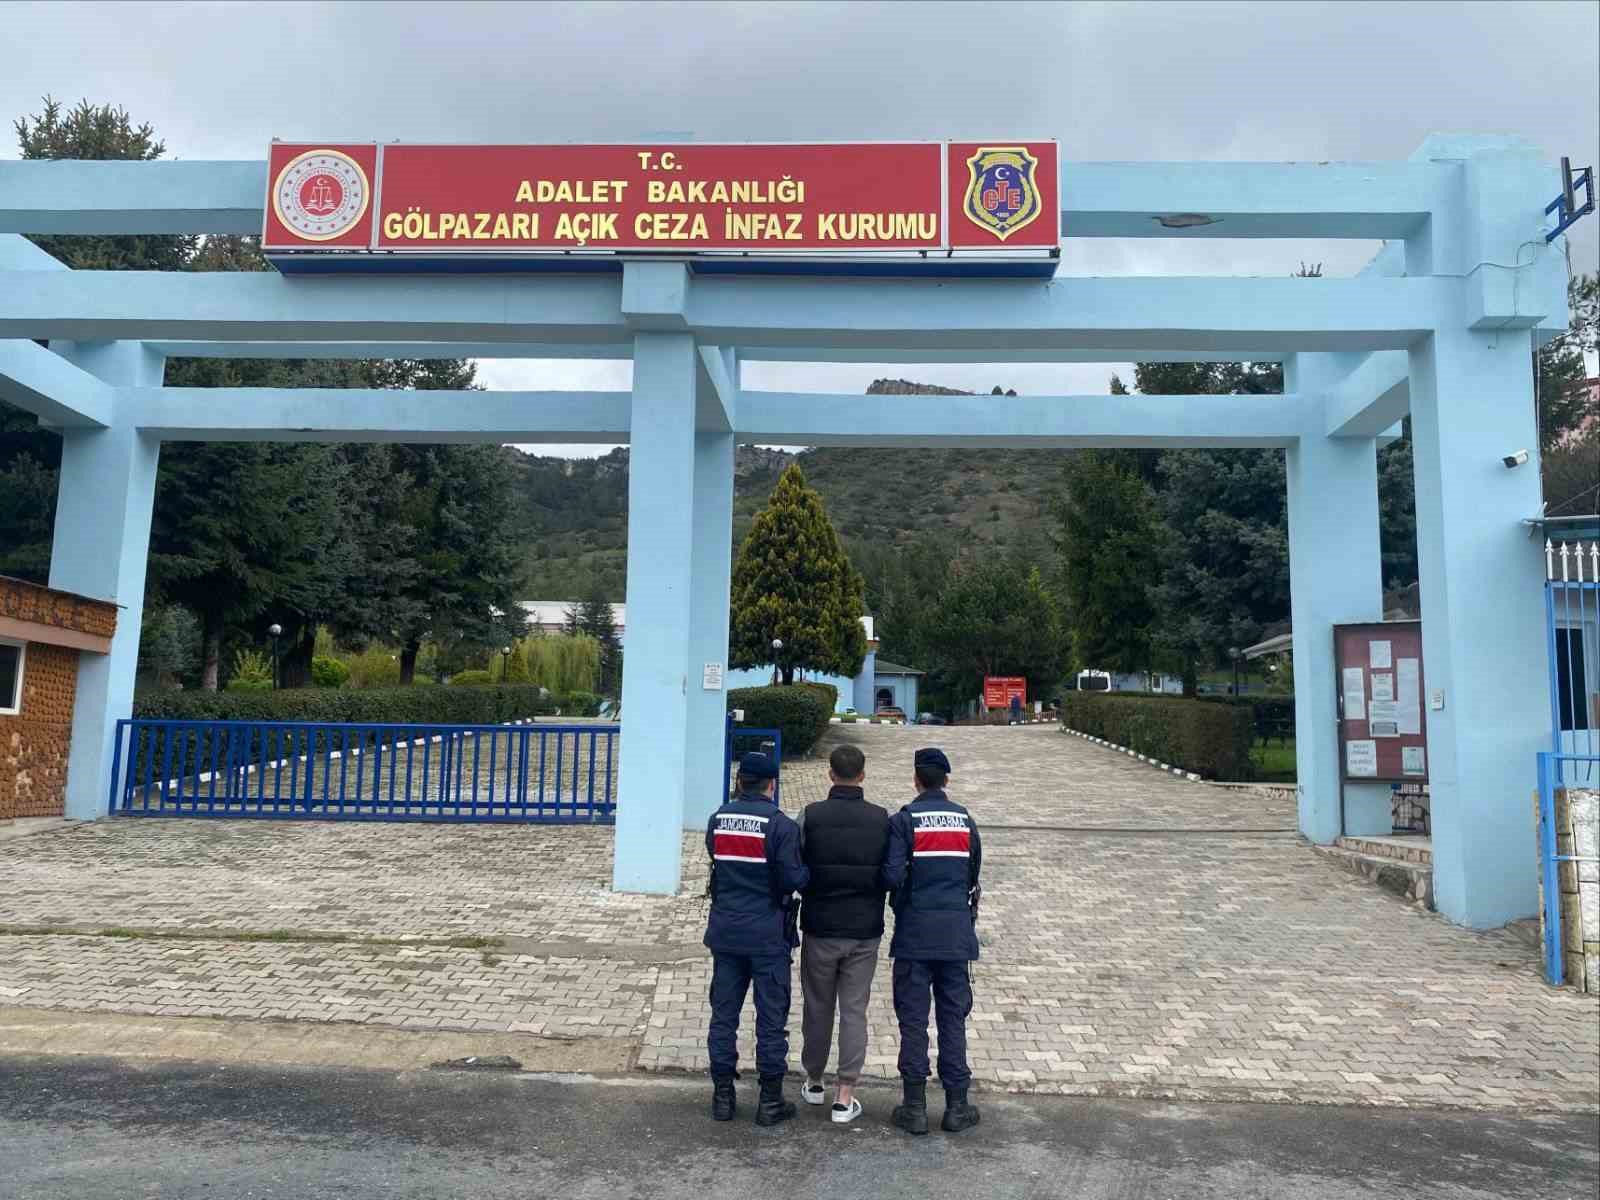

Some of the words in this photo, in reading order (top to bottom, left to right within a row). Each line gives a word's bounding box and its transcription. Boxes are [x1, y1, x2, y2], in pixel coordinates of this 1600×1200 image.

[638, 151, 683, 170] T.C.
[516, 180, 629, 203] ADALET
[647, 175, 805, 203] BAKANLIĞI
[383, 207, 540, 240] GÖLPAZARI
[553, 212, 619, 247] AÇIK
[634, 212, 710, 240] CEZA
[725, 207, 803, 240] İNFAZ
[818, 212, 937, 241] KURUMU
[718, 817, 761, 833] JANDARMA
[919, 815, 966, 829] JANDARMA
